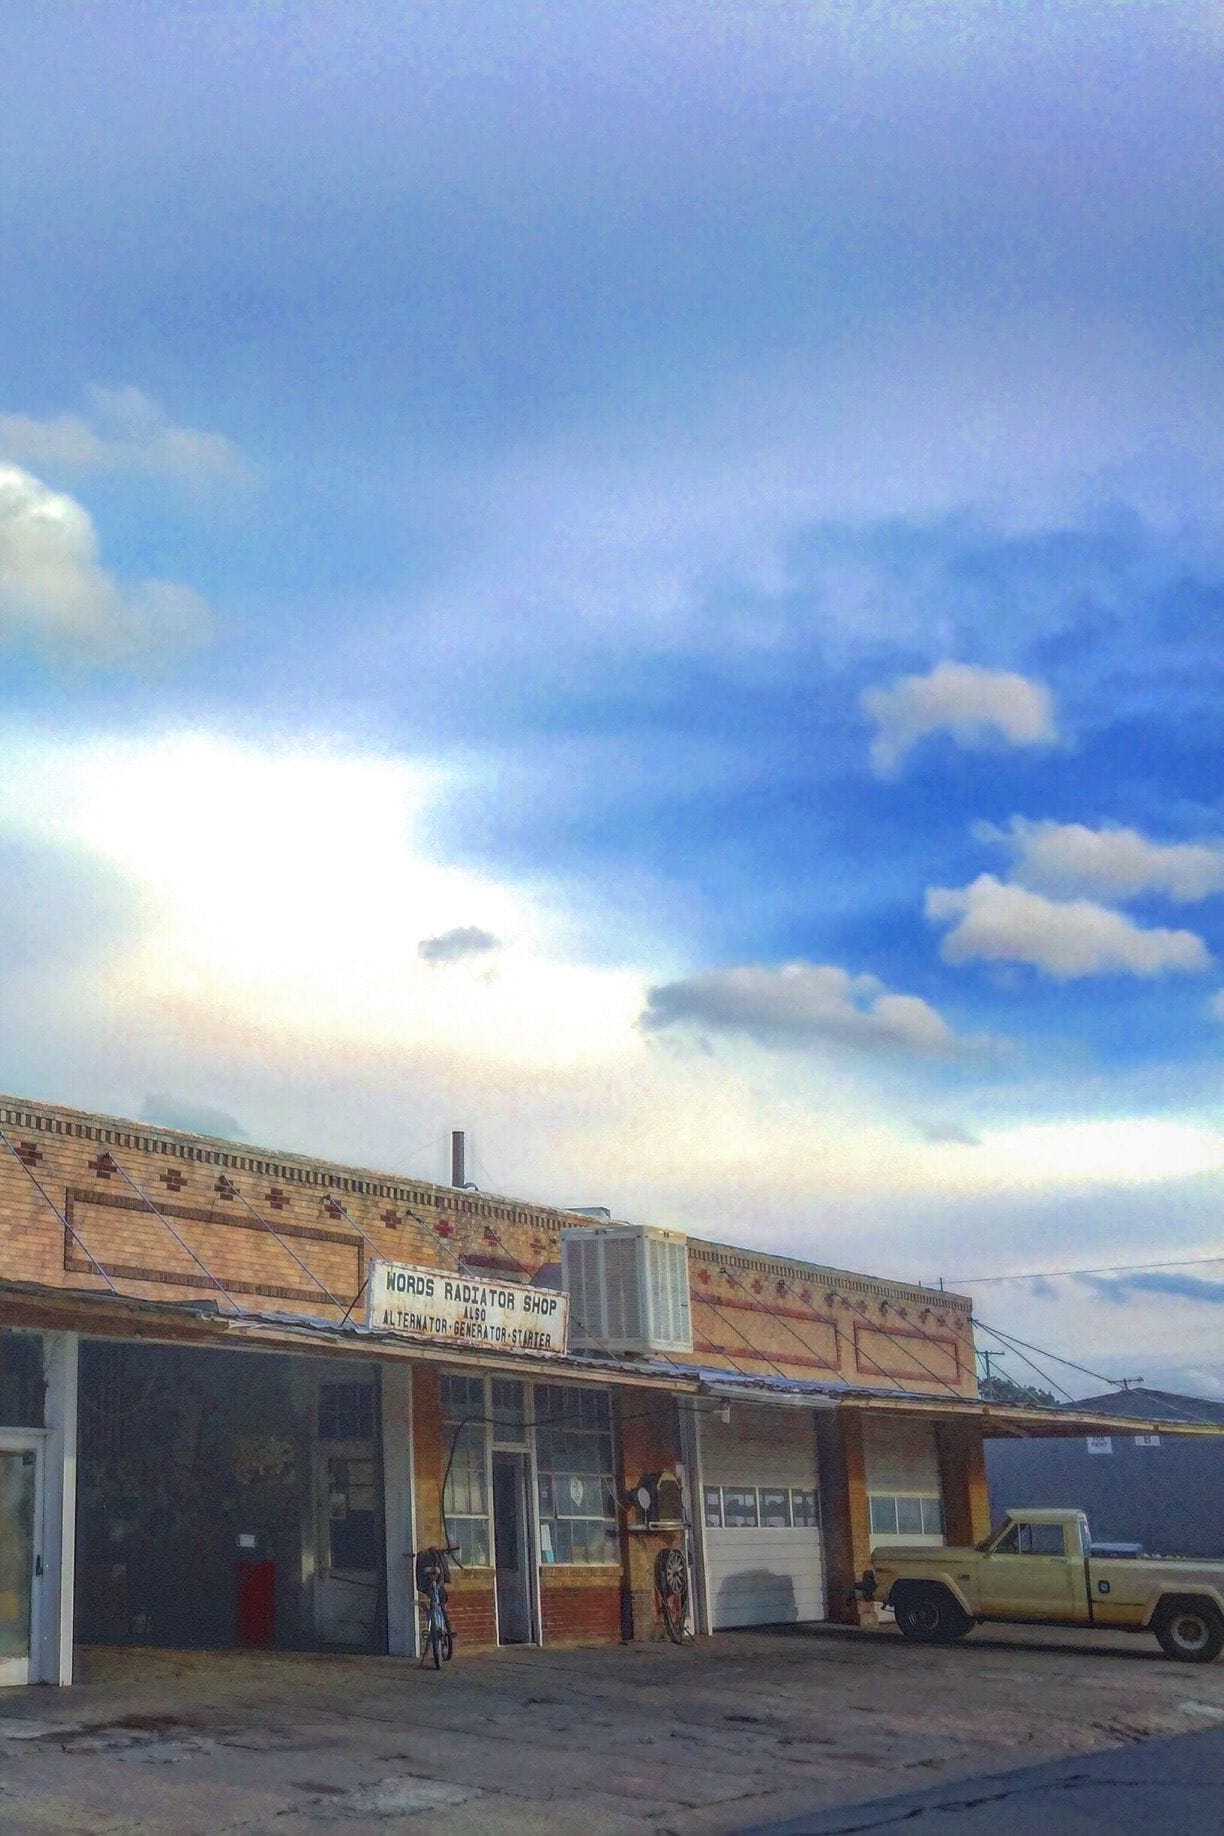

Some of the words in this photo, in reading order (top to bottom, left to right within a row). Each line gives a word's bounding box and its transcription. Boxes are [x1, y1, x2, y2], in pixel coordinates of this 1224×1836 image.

[386, 1271, 435, 1298] WORDS
[444, 1282, 515, 1311] RADIATOR
[523, 1294, 557, 1317] SHOP
[463, 1305, 487, 1322] ALSO
[382, 1309, 447, 1333] ALTERNATOR
[453, 1320, 507, 1342] GENERATOR
[510, 1329, 552, 1348] STARTER
